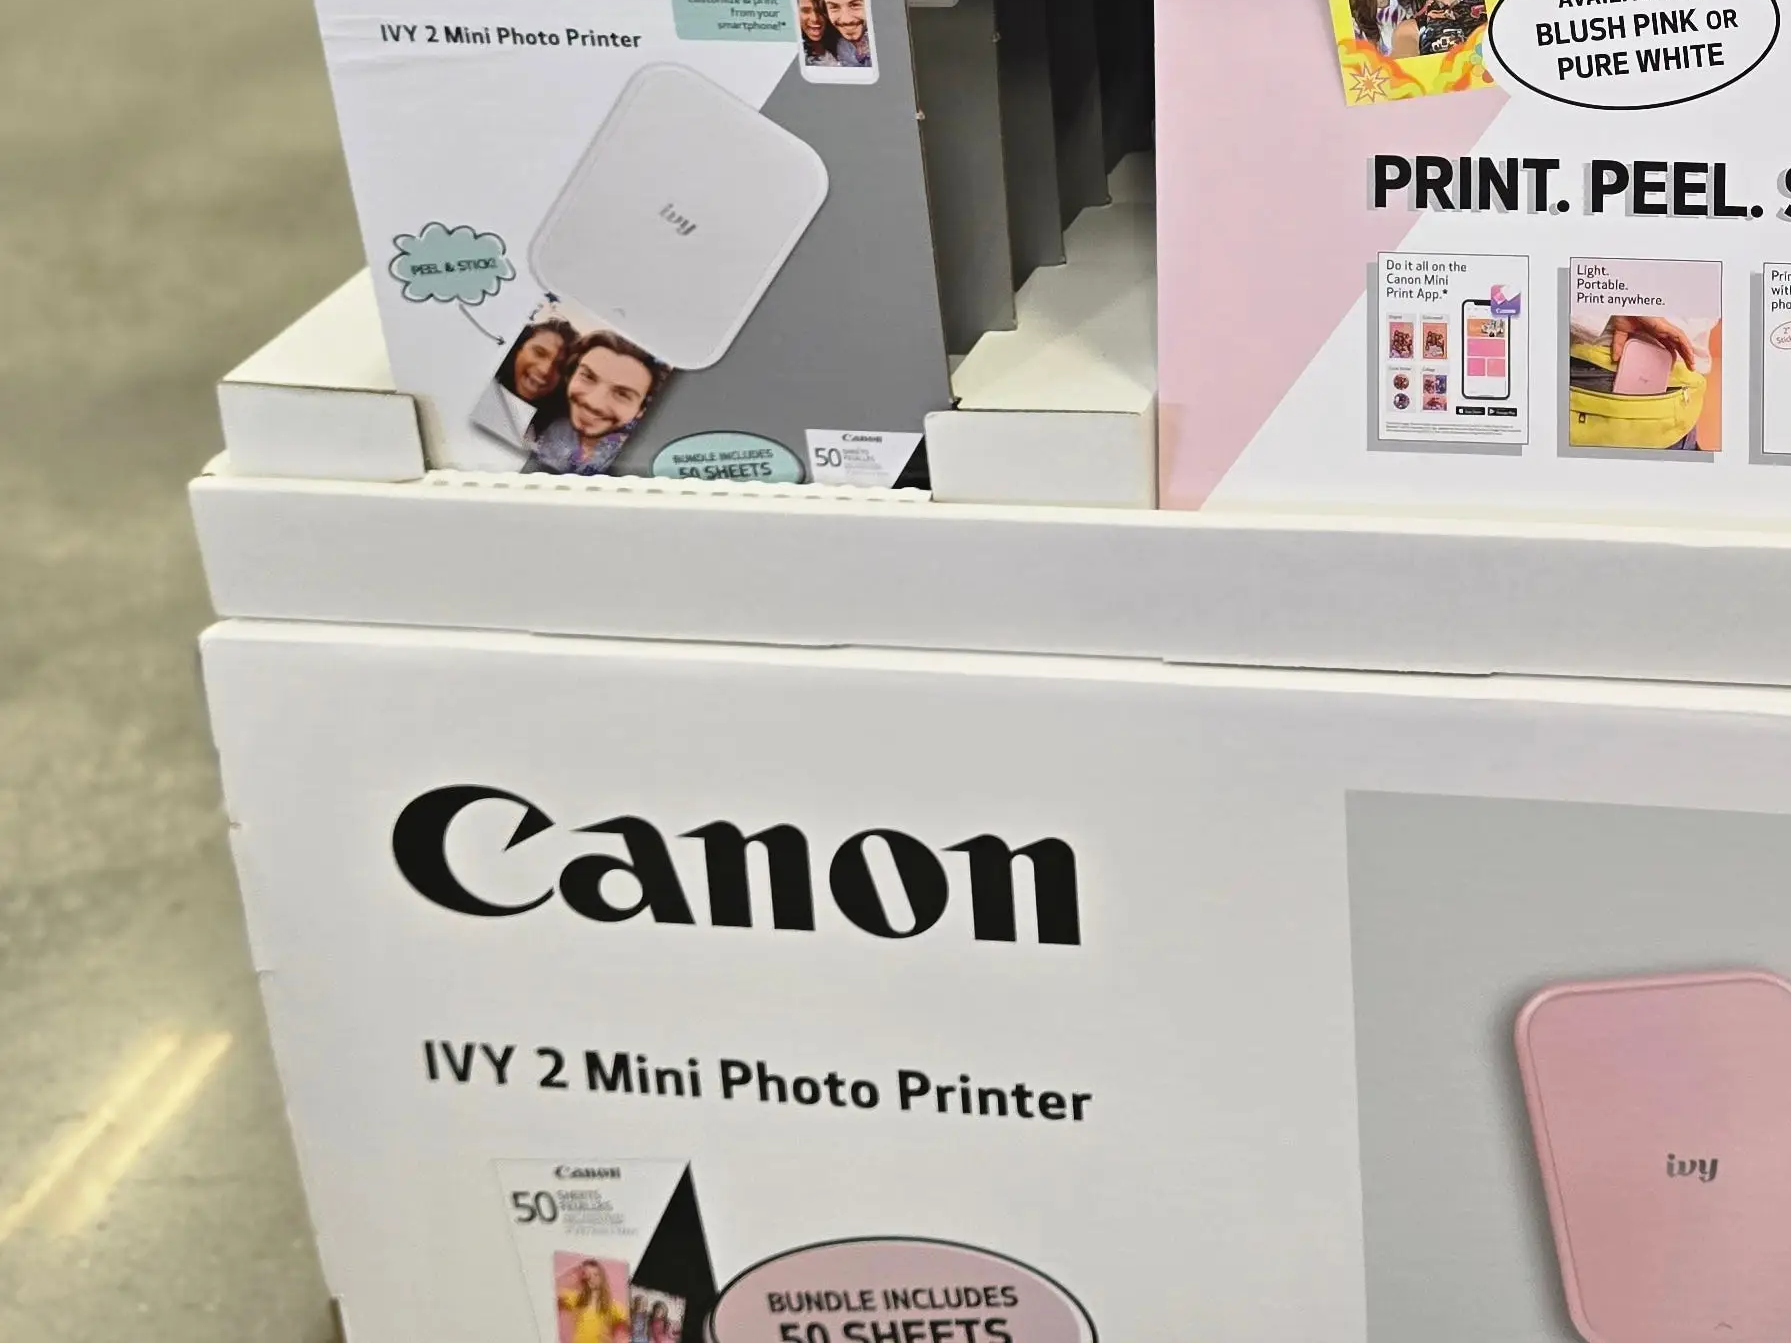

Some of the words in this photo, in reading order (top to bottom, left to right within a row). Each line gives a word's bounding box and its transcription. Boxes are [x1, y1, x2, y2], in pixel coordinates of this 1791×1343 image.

[381, 25, 417, 42] IVY
[425, 25, 439, 43] 2
[444, 26, 491, 44] Mini
[497, 27, 560, 45] Photo
[566, 29, 641, 48] Printer
[1536, 16, 1626, 46] BLUSH
[1634, 9, 1699, 37] PINK
[1707, 9, 1738, 30] OR
[1558, 52, 1629, 80] PURE
[1636, 43, 1724, 73] WHITE
[1375, 155, 1570, 212] PRINT.
[1592, 160, 1763, 218] PEEL.
[1387, 260, 1401, 270] Do
[1405, 261, 1413, 271] it
[1416, 261, 1428, 271] all
[1432, 264, 1445, 272] on
[1449, 261, 1466, 272] the
[1387, 273, 1421, 284] Canon
[1424, 275, 1448, 285] Mini
[1578, 265, 1609, 278] Light.
[1386, 287, 1413, 299] Print
[1577, 279, 1628, 290] Portable.
[1577, 292, 1604, 304] Print
[1608, 294, 1665, 307] anywhere.
[392, 785, 1081, 945] Canon
[425, 1041, 514, 1084] IVY
[537, 1048, 568, 1088] 2
[586, 1051, 701, 1097] Mini
[720, 1059, 879, 1109] Photo
[898, 1070, 1092, 1121] Printer
[1667, 1154, 1718, 1183] ivy
[512, 1191, 558, 1223] 50
[768, 1291, 876, 1313] BUNDLE
[884, 1286, 1018, 1310] INCLUDES
